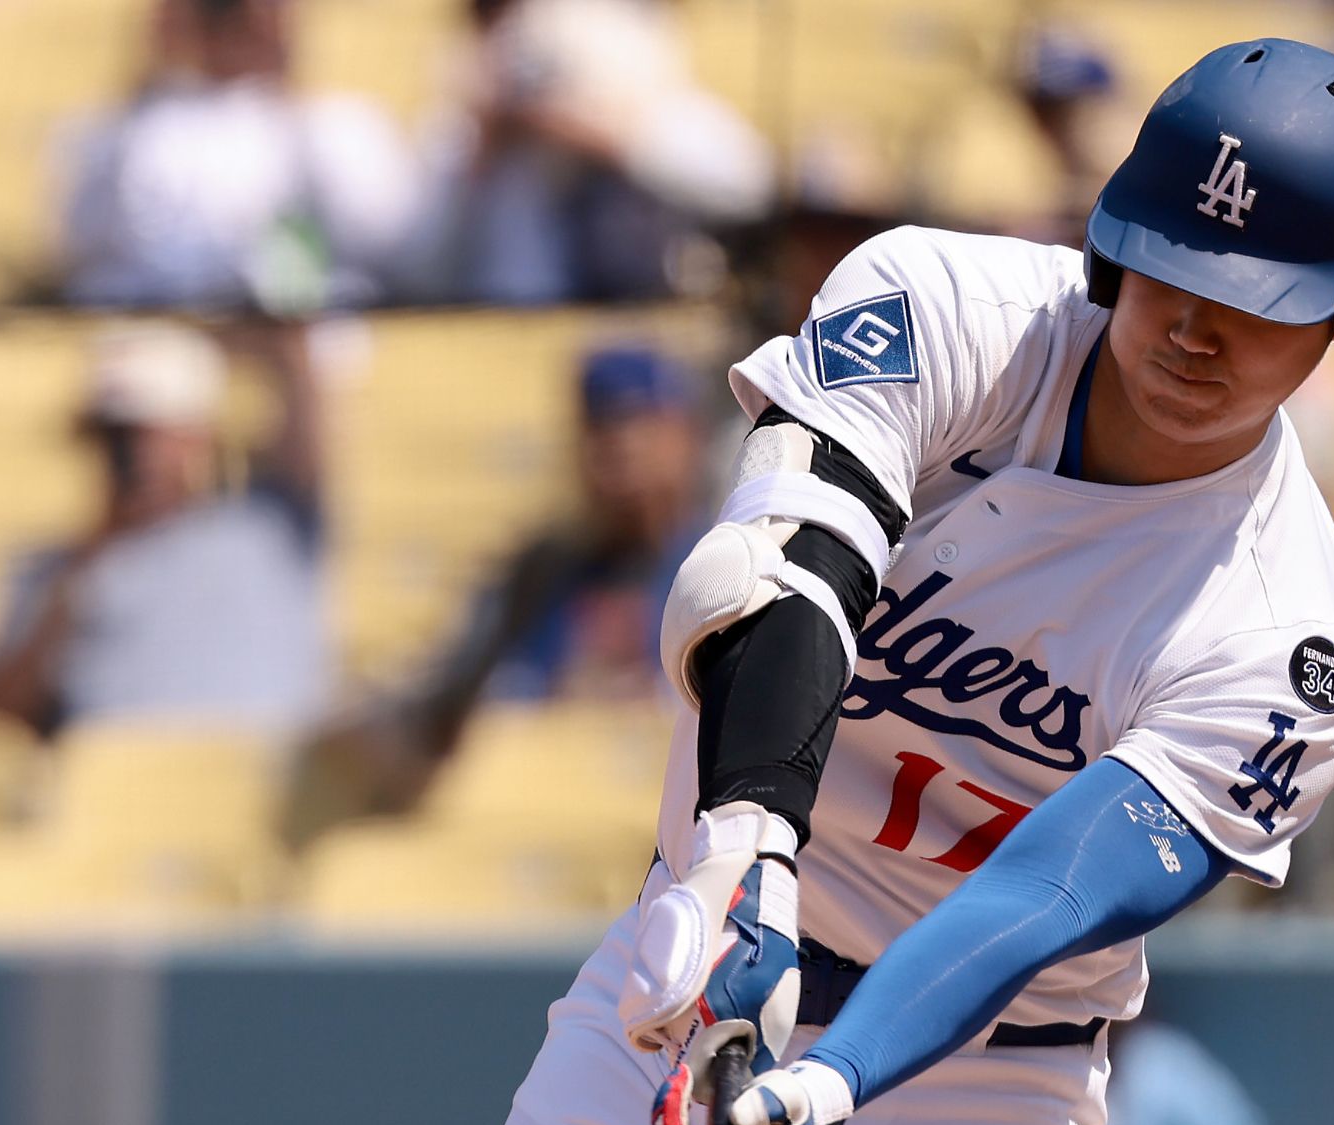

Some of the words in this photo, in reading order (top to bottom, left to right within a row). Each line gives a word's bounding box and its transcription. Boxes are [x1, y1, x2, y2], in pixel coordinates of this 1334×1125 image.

[1197, 134, 1257, 228] LA
[841, 311, 901, 357] G
[839, 570, 1092, 772] dgers
[871, 751, 1034, 873] 17
[1227, 710, 1309, 835] LA
